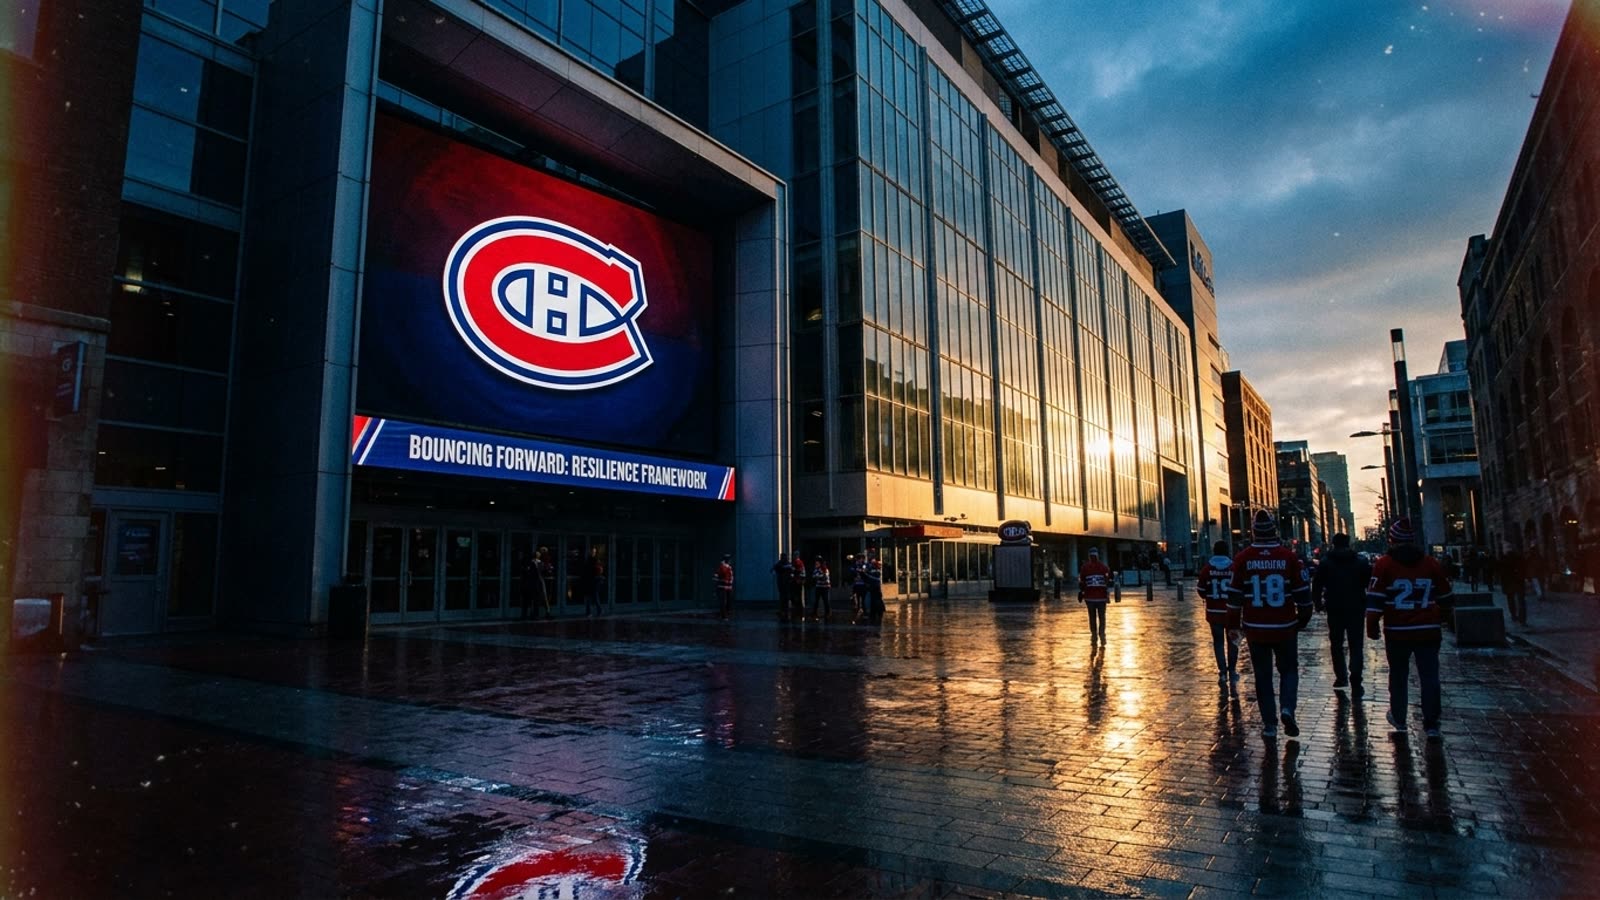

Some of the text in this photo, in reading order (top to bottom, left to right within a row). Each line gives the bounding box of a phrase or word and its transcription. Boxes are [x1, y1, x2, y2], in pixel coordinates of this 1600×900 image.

[409, 434, 707, 490] BOUNCING FORWARD: RESILIENCE FRAMEWORK
[1250, 573, 1286, 608] 18
[1392, 578, 1433, 610] 27
